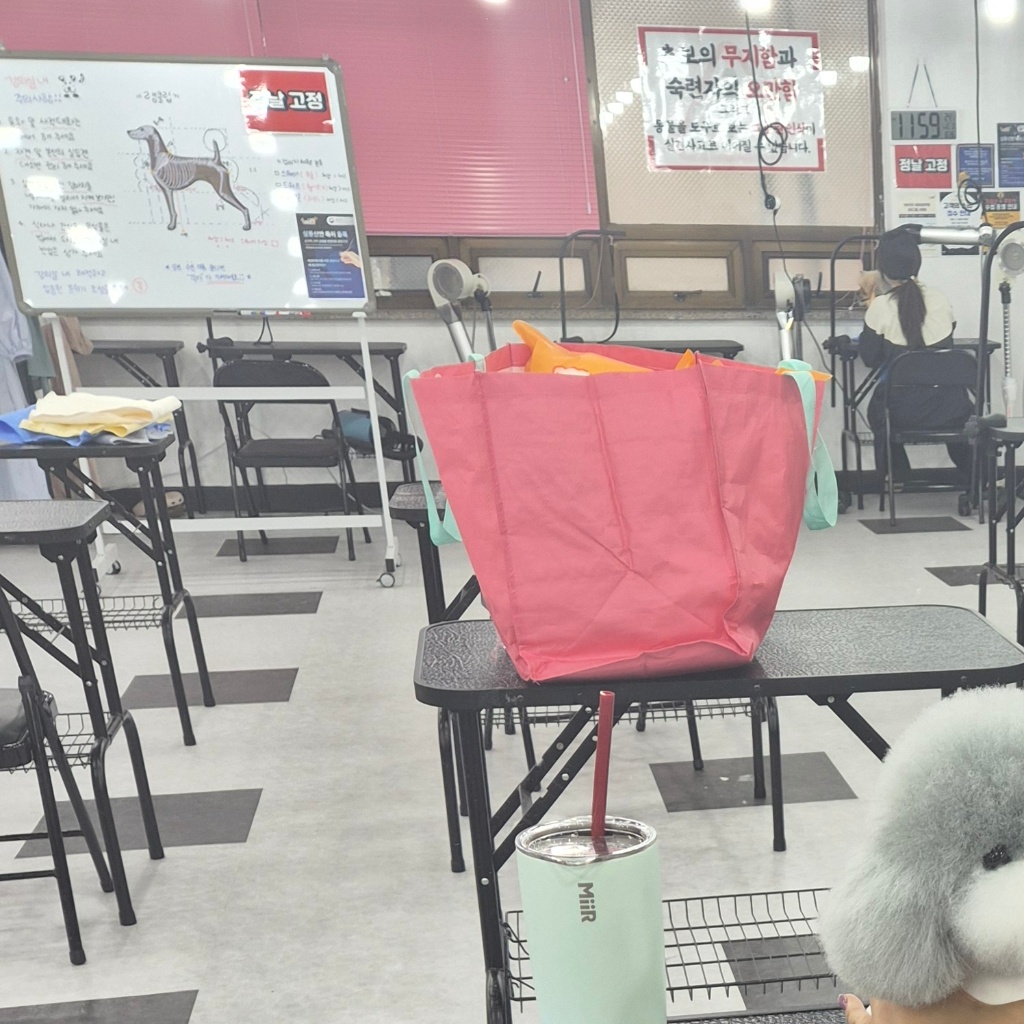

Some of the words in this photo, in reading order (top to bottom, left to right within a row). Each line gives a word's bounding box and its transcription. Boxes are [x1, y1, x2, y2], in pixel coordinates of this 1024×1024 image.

[721, 43, 798, 69] 무지함과
[247, 90, 286, 110] 날
[288, 90, 324, 111] 고정
[899, 158, 923, 172] 정날
[925, 158, 949, 172] 고정
[578, 882, 597, 923] MiiR
